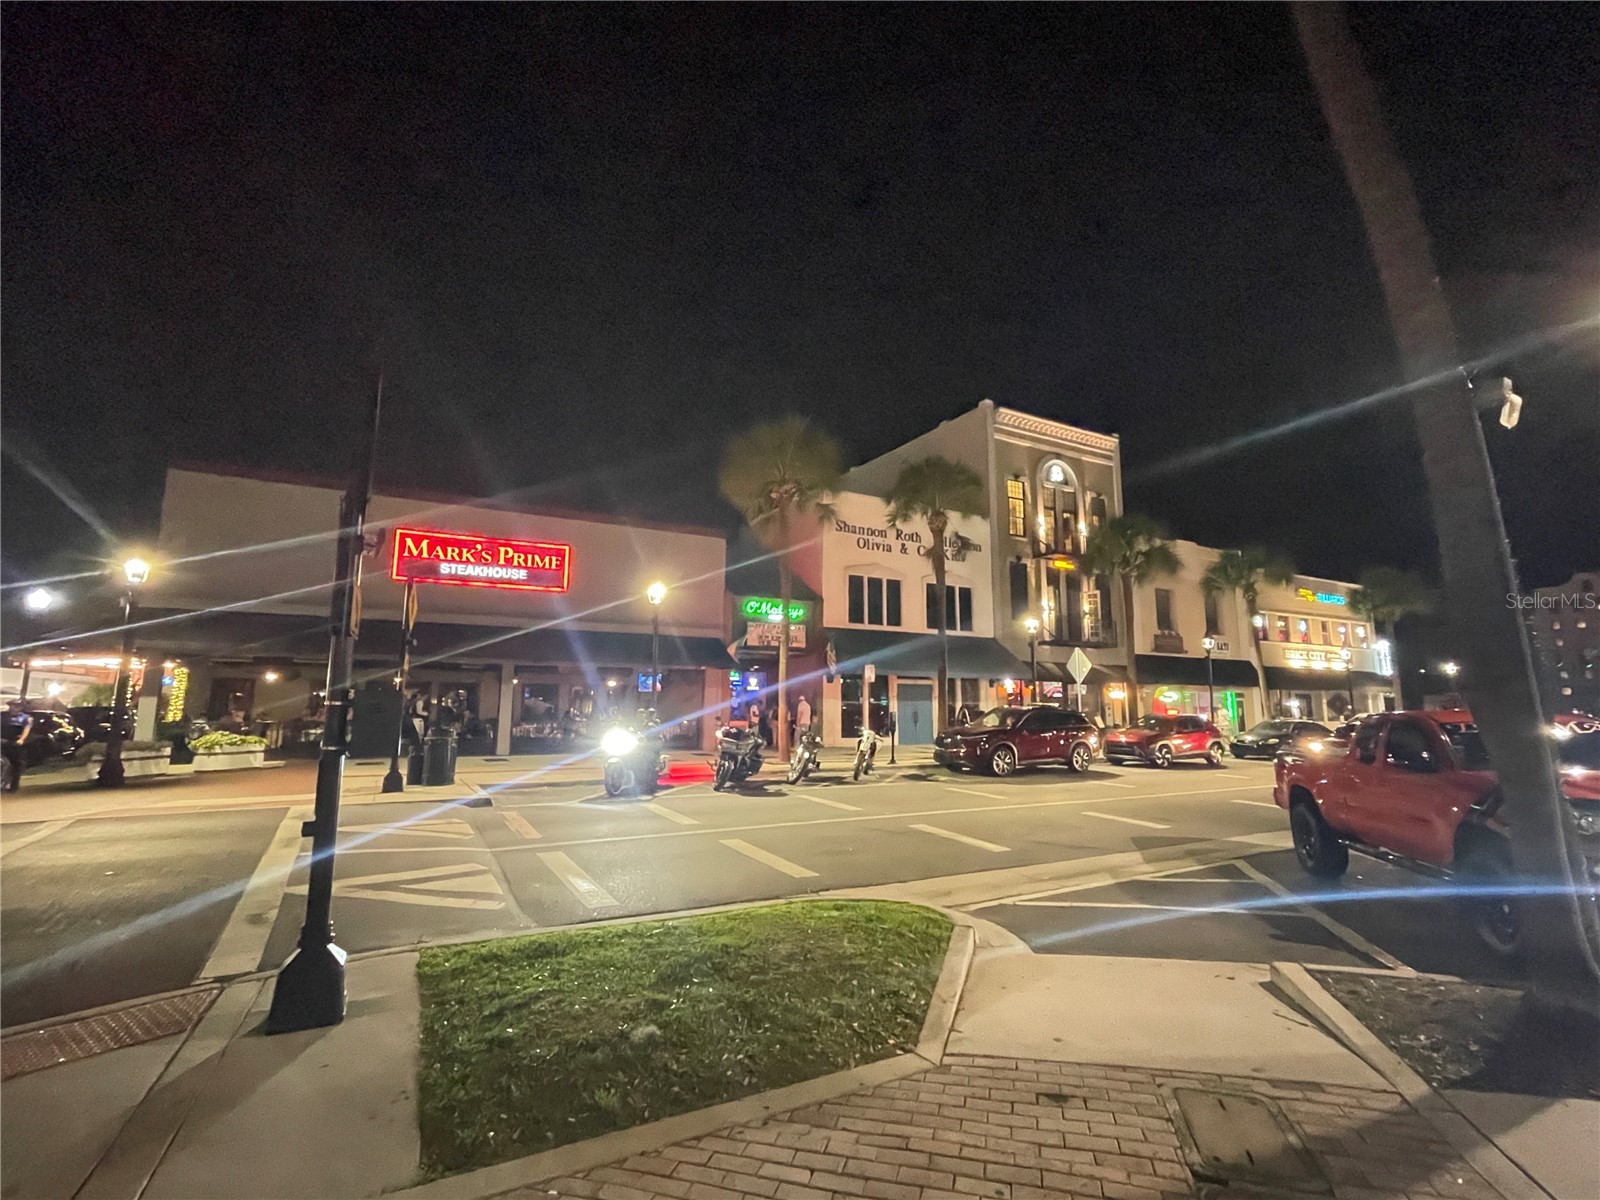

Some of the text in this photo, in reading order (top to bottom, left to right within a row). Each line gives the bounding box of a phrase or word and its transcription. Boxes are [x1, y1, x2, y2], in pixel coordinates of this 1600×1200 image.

[835, 519, 888, 539] Shannon
[895, 528, 922, 544] Roth
[856, 537, 893, 553] Olivia
[900, 543, 909, 555] &
[497, 546, 562, 570] PRIME
[440, 563, 528, 580] STEAKHOUSE
